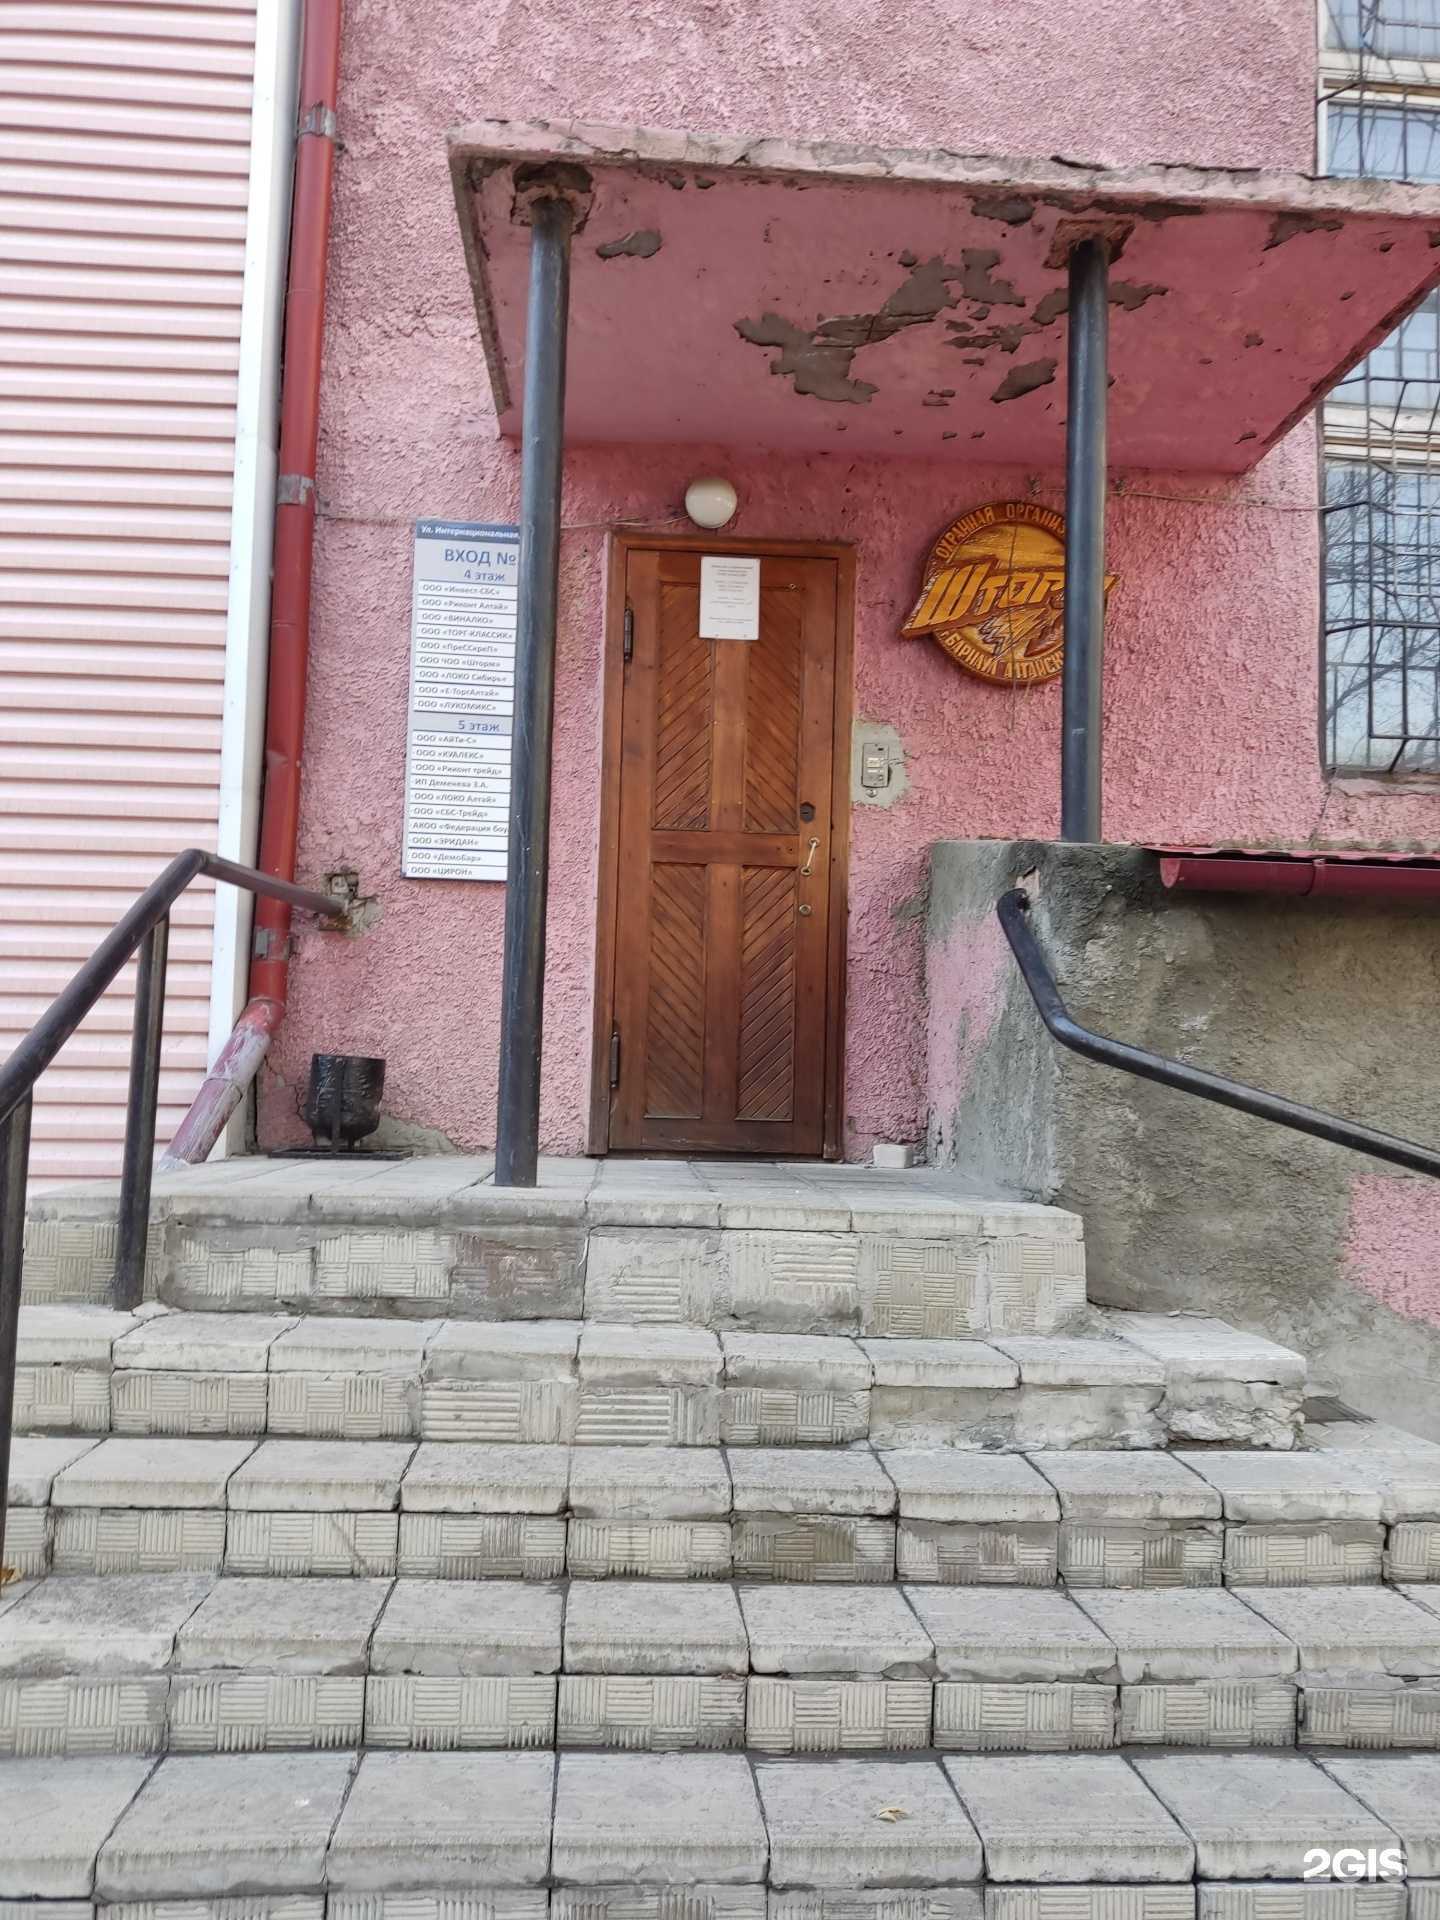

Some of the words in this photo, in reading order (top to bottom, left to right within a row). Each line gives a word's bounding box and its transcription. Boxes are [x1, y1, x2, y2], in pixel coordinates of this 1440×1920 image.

[935, 506, 996, 561] ОХРАННАЯ
[1006, 503, 1065, 537] ОРГАНИЗ
[444, 549, 491, 567] ВХОД
[497, 552, 516, 566] №
[464, 569, 471, 579] 4
[475, 572, 506, 582] этаж
[423, 584, 442, 592] ООО
[908, 559, 1120, 630] Штор
[422, 598, 442, 607] ООО
[421, 627, 440, 635] ООО
[420, 641, 440, 650] ООО
[420, 656, 440, 664] ООО
[1004, 650, 1064, 679] АЛТАЙСК
[420, 670, 439, 679] ООО
[419, 686, 438, 694] ООО
[418, 700, 437, 708] ООО
[458, 719, 465, 730] 5
[470, 722, 500, 732] этаж
[417, 734, 436, 742] ООО
[416, 749, 436, 757] ООО
[415, 763, 435, 772] ООО
[414, 792, 434, 801] ООО
[414, 807, 433, 815] ООО
[492, 824, 511, 835] боу
[412, 836, 432, 845] ООО
[411, 851, 431, 860] ООО
[411, 866, 430, 875] ООО
